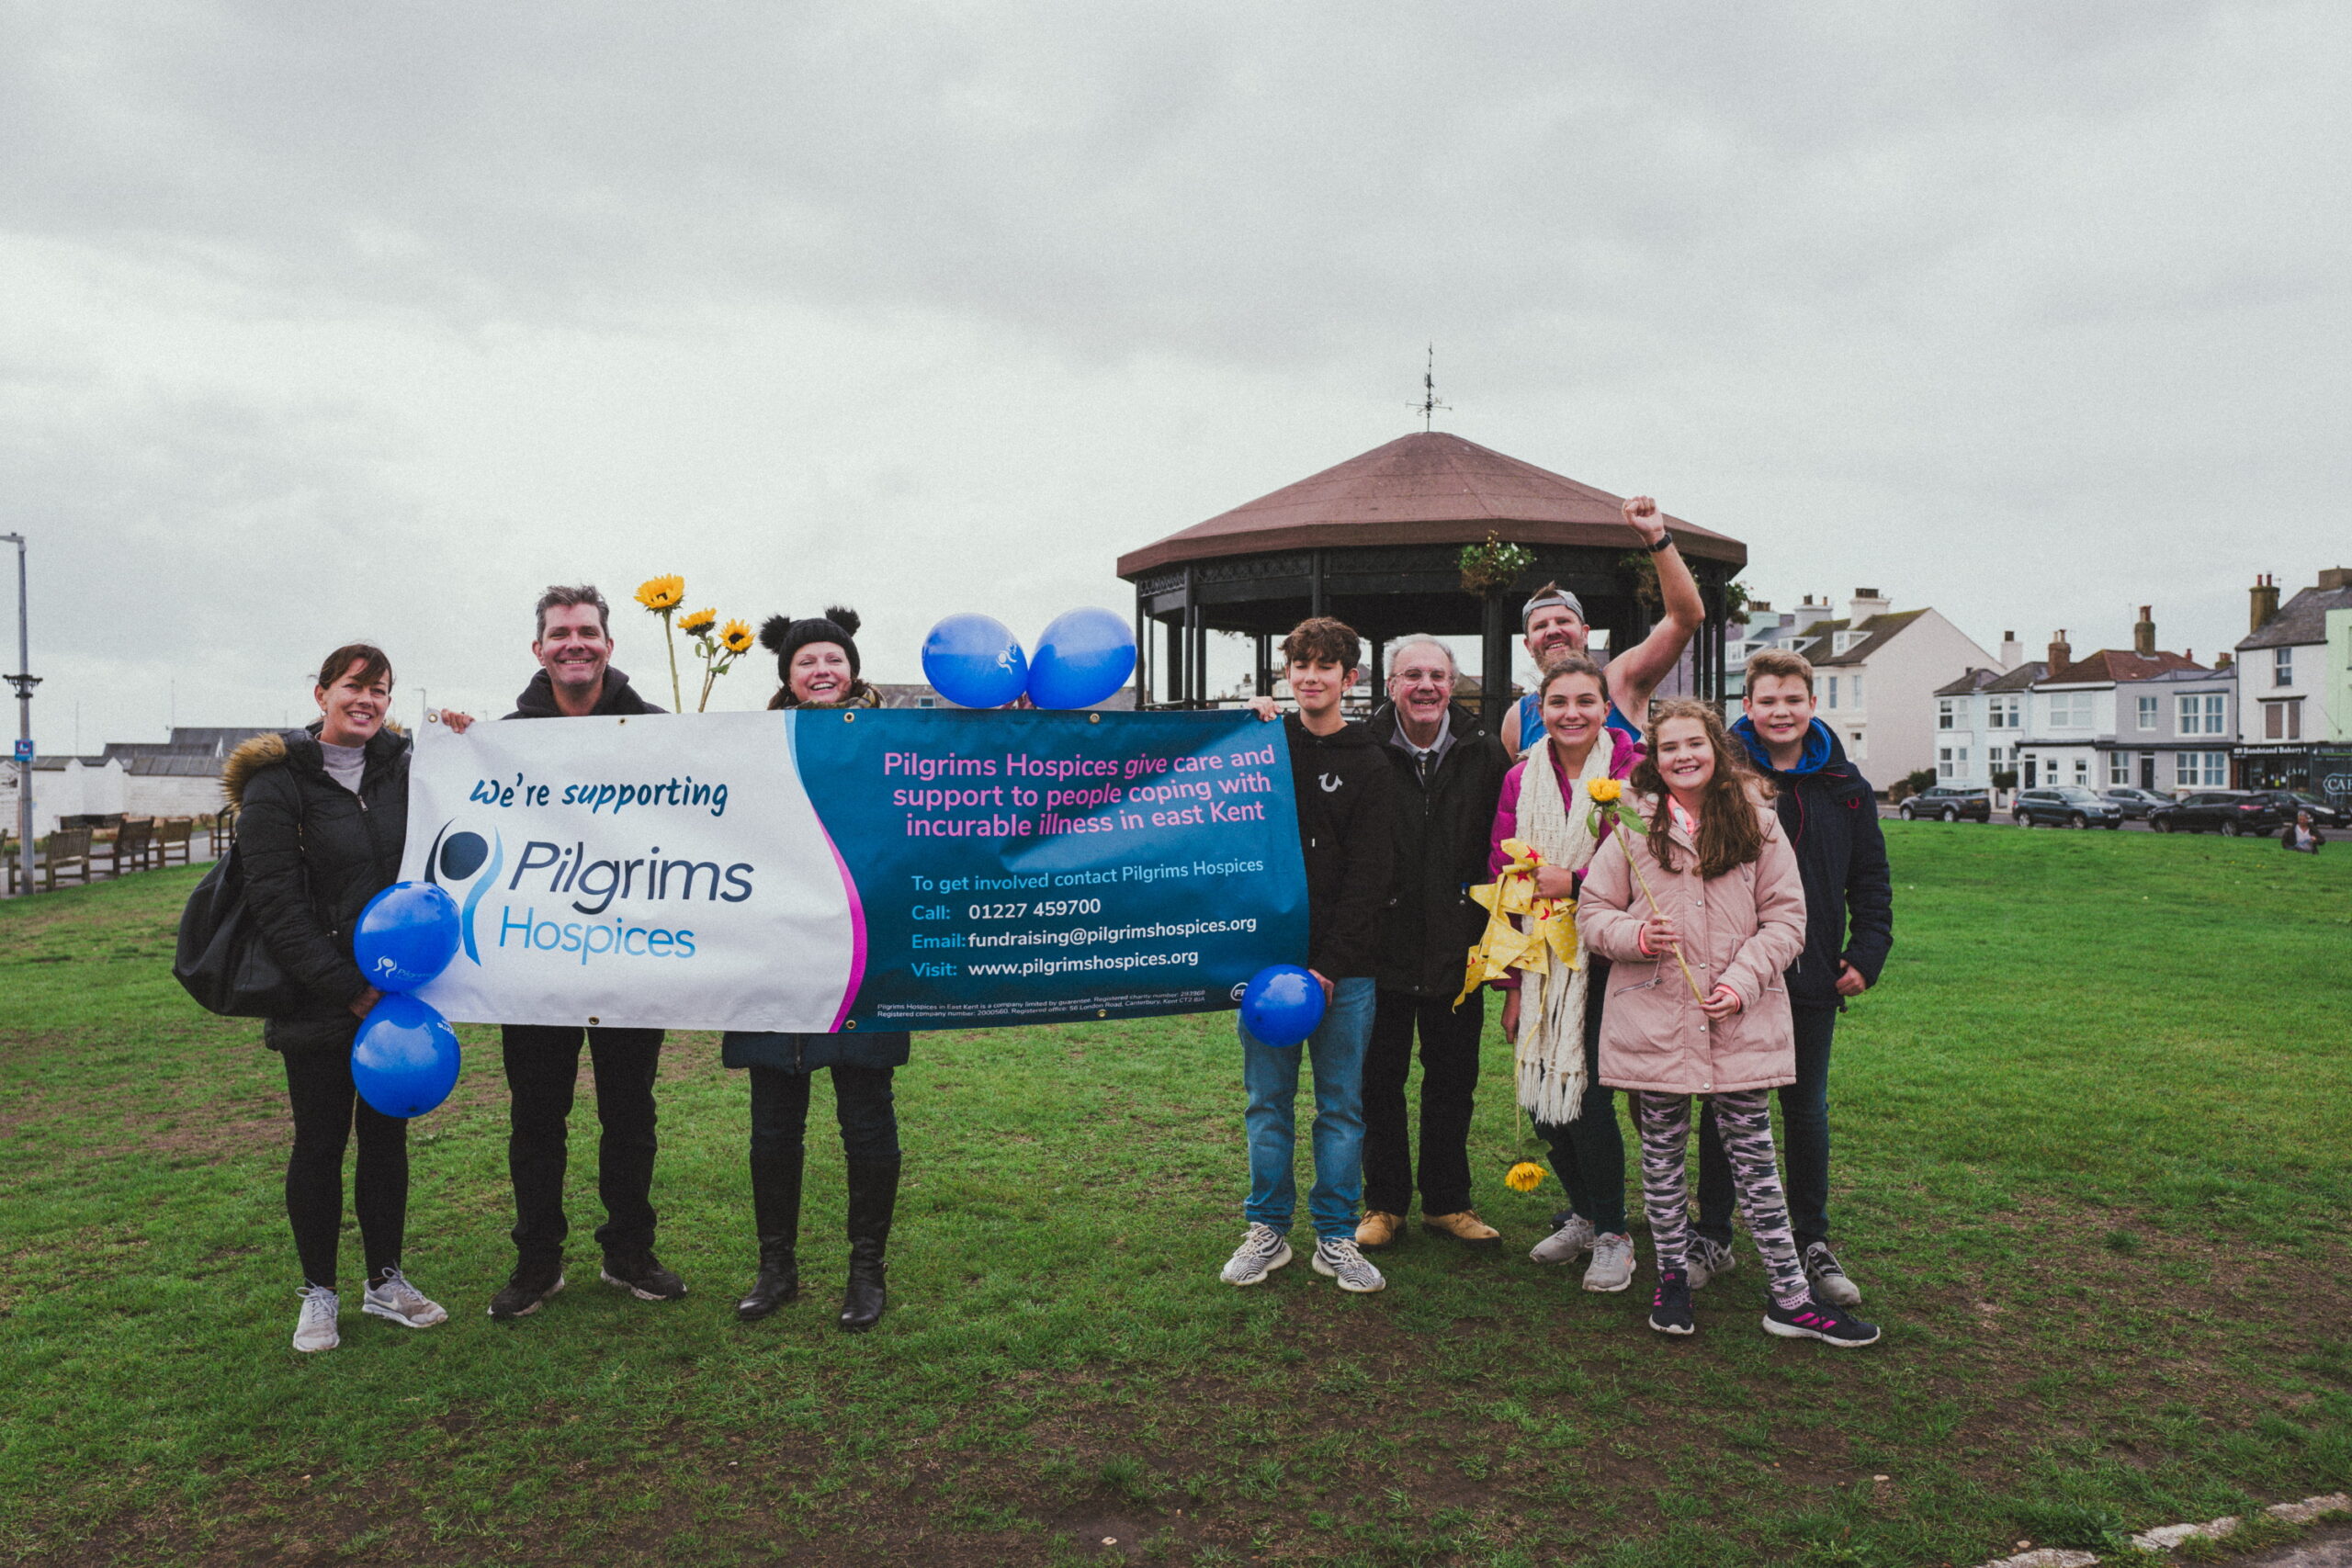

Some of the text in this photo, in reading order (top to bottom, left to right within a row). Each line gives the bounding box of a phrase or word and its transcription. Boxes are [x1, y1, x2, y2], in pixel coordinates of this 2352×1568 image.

[884, 744, 1276, 782] Pilgrims Hospices give care and
[2244, 746, 2278, 754] Bandstand
[2278, 746, 2302, 755] Bakery
[562, 776, 729, 817] supporting
[893, 772, 1272, 811] support to people coping with
[906, 800, 1265, 837] incurable illness in east Kent
[508, 840, 754, 915] Pilgrims
[911, 857, 1264, 895] To get involved contact Pilgrims Hospices
[911, 897, 1102, 920] Call: 01227 459700
[499, 906, 696, 965] Hospices
[911, 917, 1257, 950] Email: fundraising@pilgrimshospices.org
[911, 951, 1199, 977] Visit: www.pilgrimshospices.org
[993, 1001, 1023, 1010] company
[1093, 994, 1129, 1003] Registered
[1129, 992, 1151, 1000] charity
[1011, 1006, 1047, 1014] Registered
